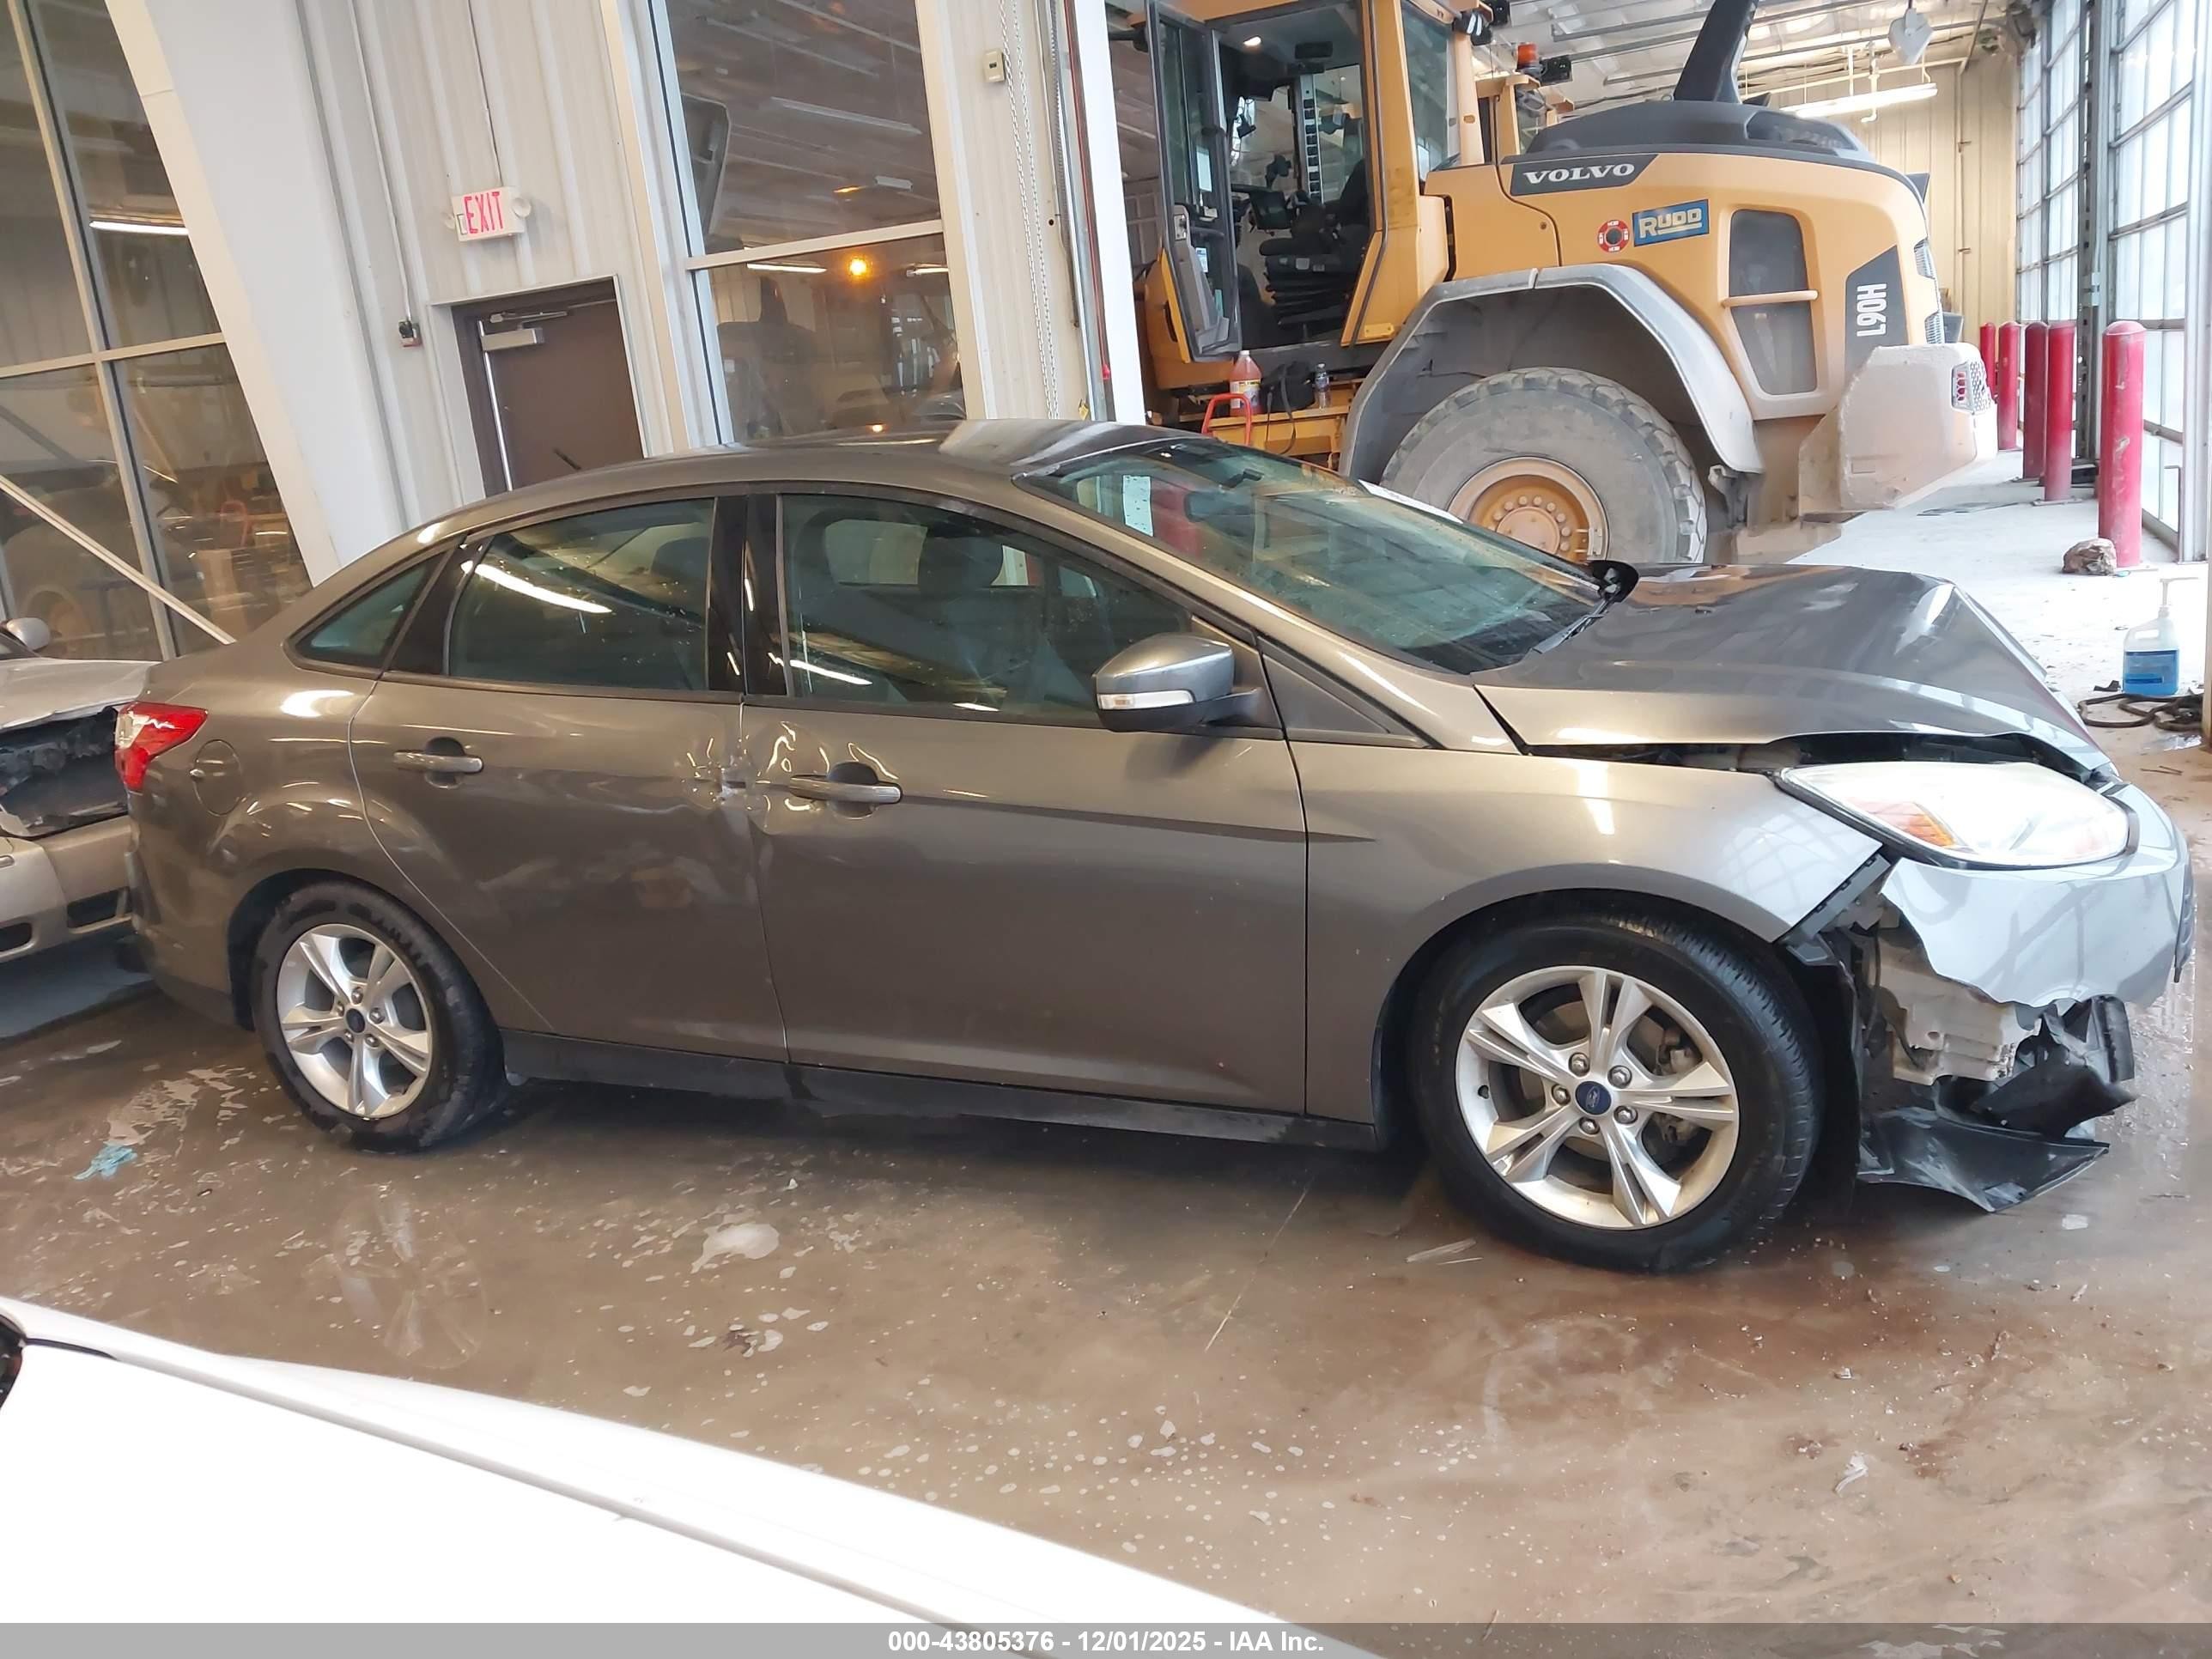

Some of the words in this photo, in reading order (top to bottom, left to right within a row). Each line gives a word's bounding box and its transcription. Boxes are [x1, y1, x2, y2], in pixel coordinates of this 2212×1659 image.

[1523, 163, 1635, 185] VOLVO
[464, 191, 503, 234] EXIT
[1856, 283, 1887, 337] L90H
